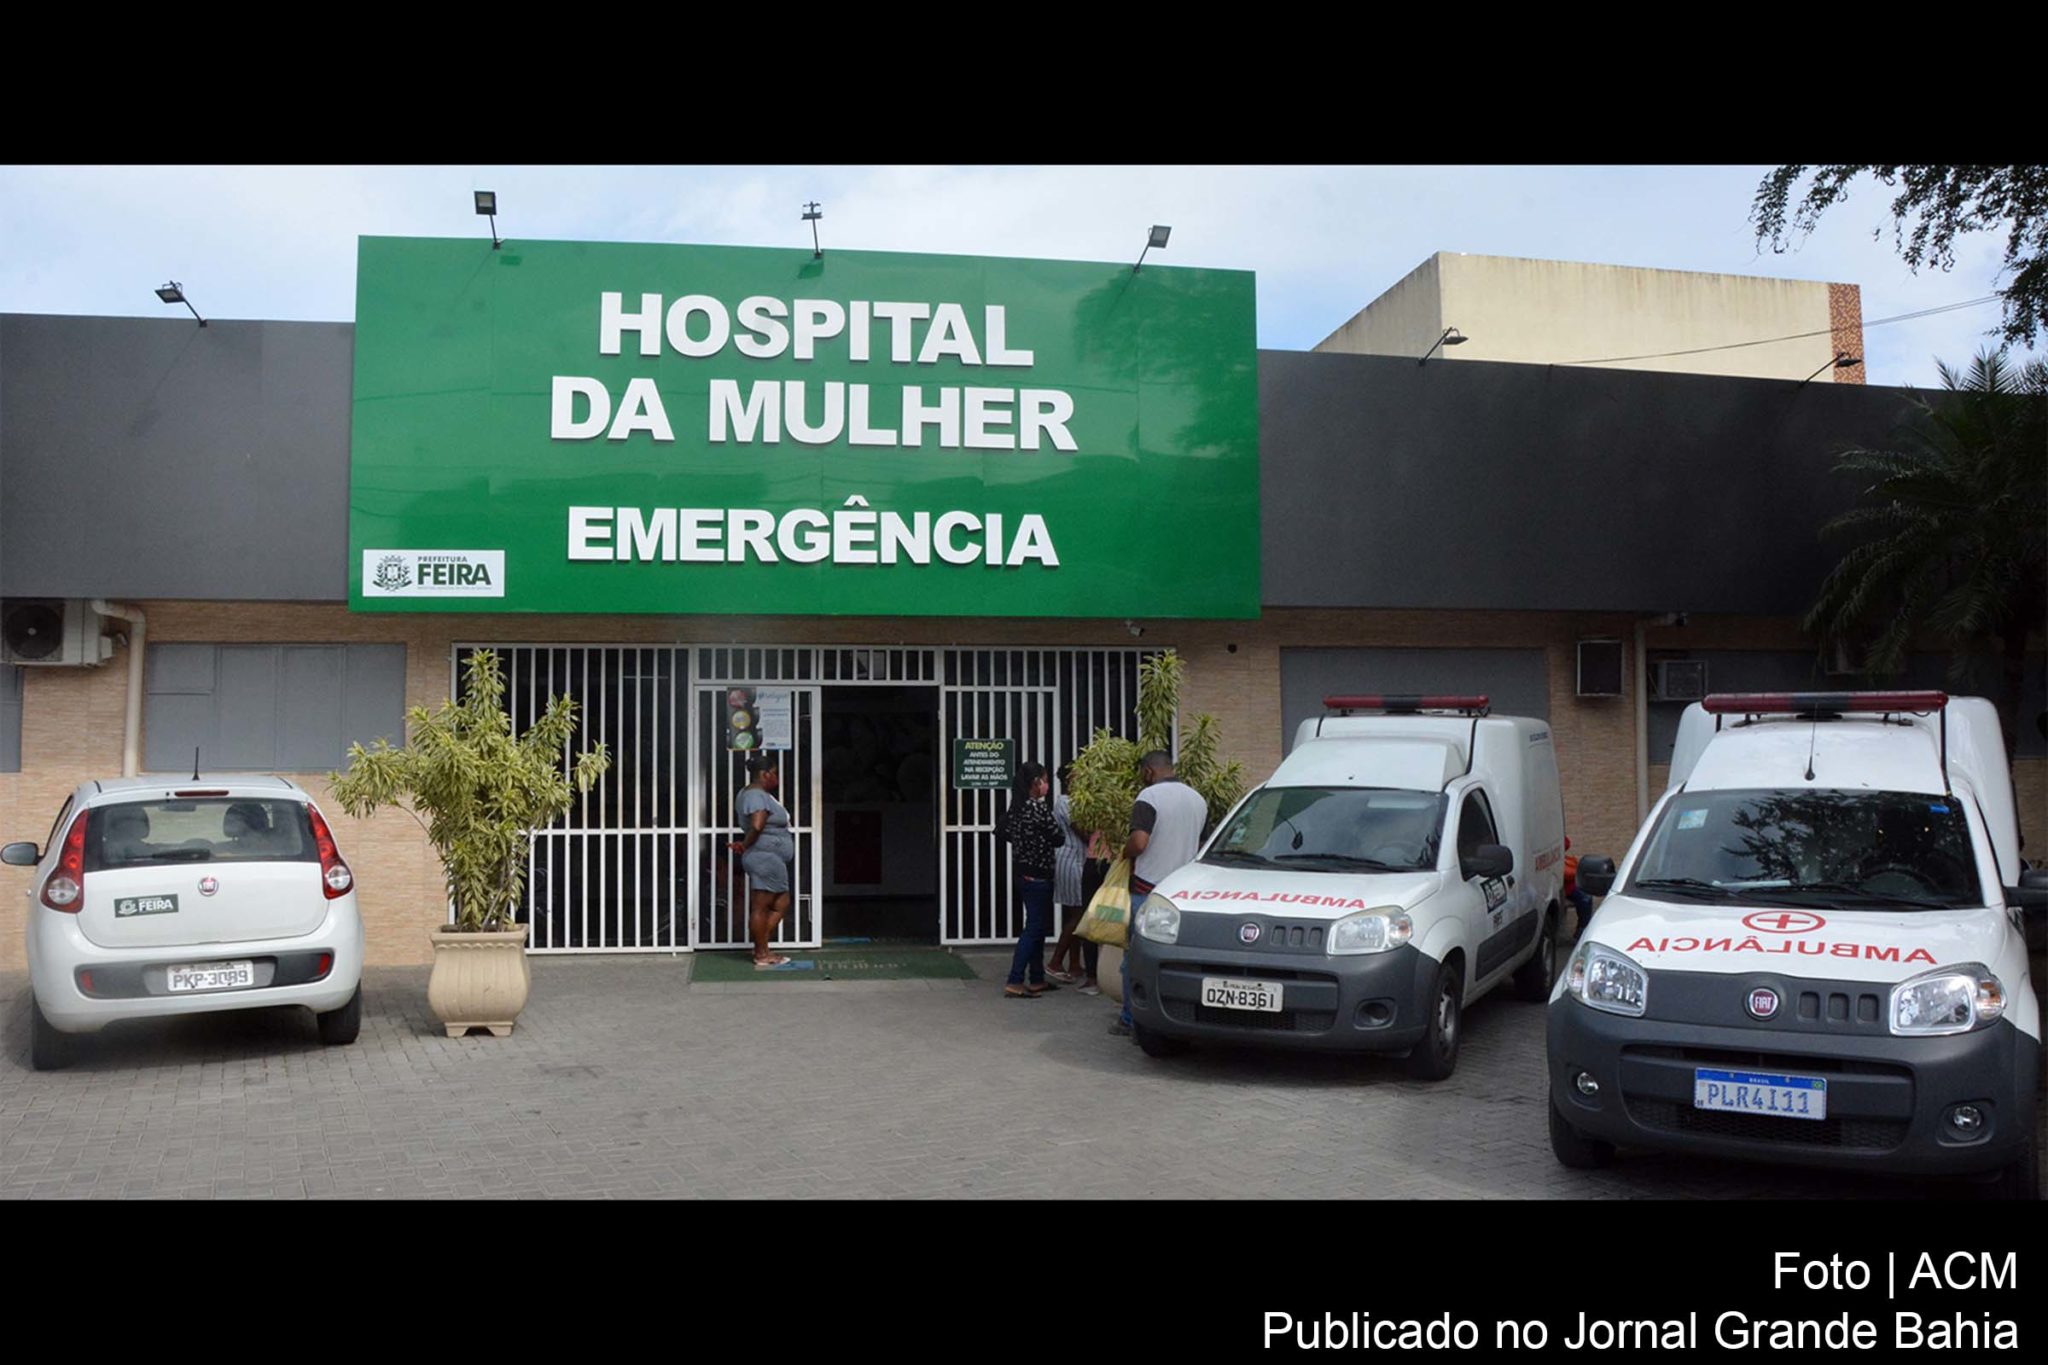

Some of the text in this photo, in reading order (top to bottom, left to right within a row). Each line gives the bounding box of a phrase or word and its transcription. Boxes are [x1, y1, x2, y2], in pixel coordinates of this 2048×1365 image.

[600, 291, 1035, 366] HOSPITAL
[551, 375, 1079, 451] DA MULHER
[567, 494, 1060, 566] EMERGÊNCIA
[417, 563, 492, 586] FEIRA
[138, 899, 174, 913] FEIRA
[1206, 988, 1275, 1009] OZN-8361
